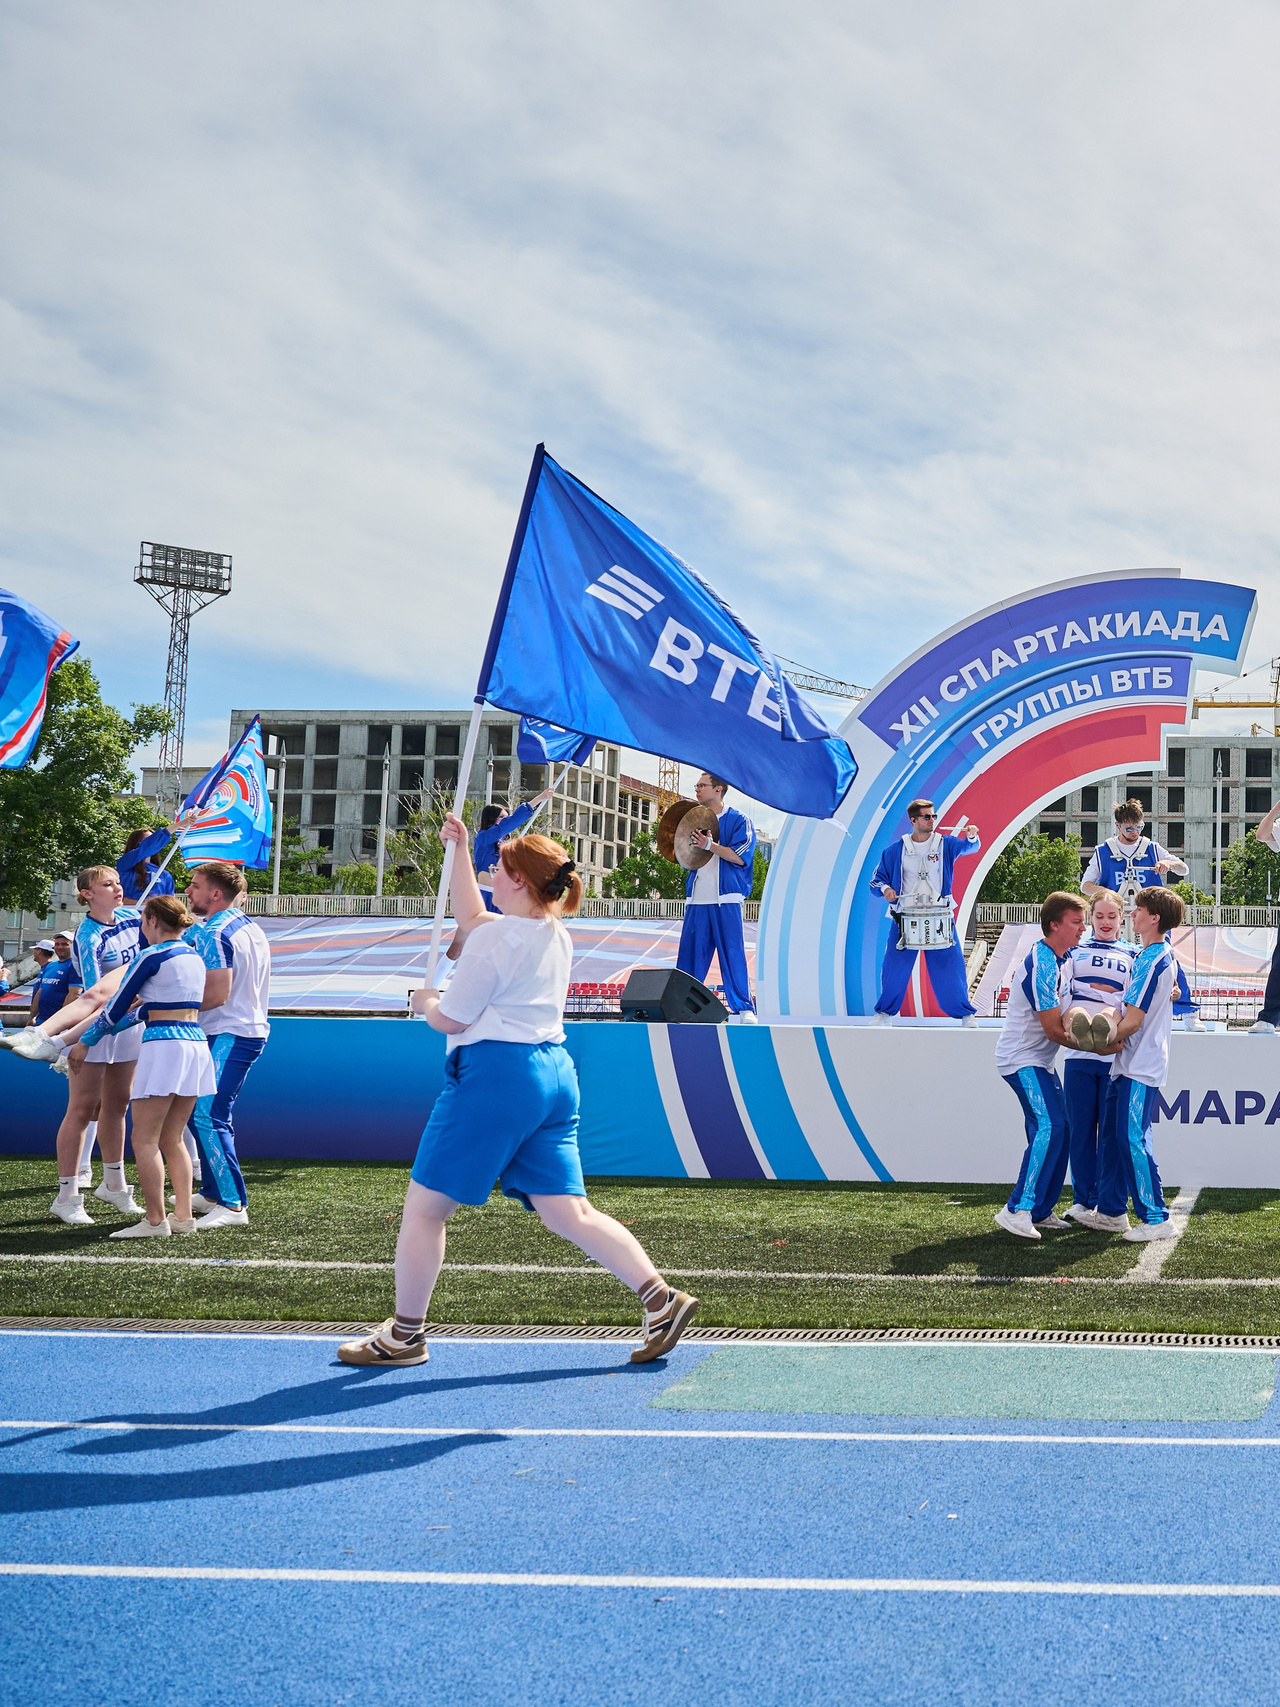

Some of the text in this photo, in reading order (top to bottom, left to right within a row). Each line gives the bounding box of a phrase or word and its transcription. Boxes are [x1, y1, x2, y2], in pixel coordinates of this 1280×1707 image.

[939, 610, 1230, 702] СПАРТАКИАДА
[971, 666, 1173, 749] ГРУППЫ ВТБ
[1115, 869, 1147, 886] ВБ
[1091, 955, 1127, 974] ВТБ
